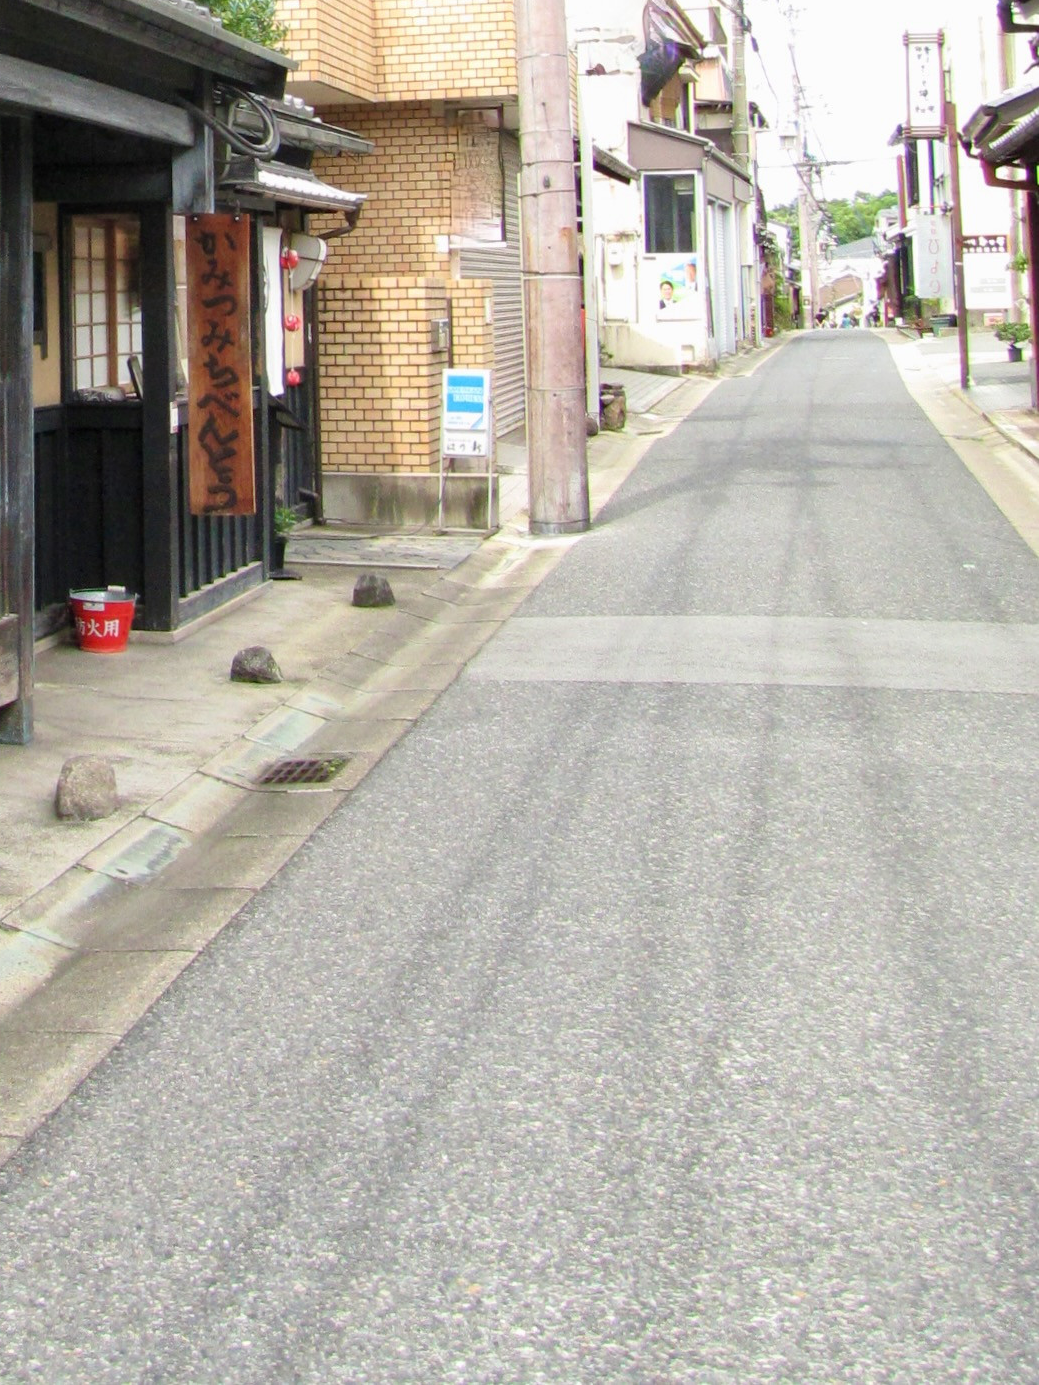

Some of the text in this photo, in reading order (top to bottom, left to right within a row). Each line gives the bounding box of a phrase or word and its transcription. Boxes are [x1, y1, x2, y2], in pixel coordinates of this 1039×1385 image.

[194, 230, 239, 513] かみつみちべんとう
